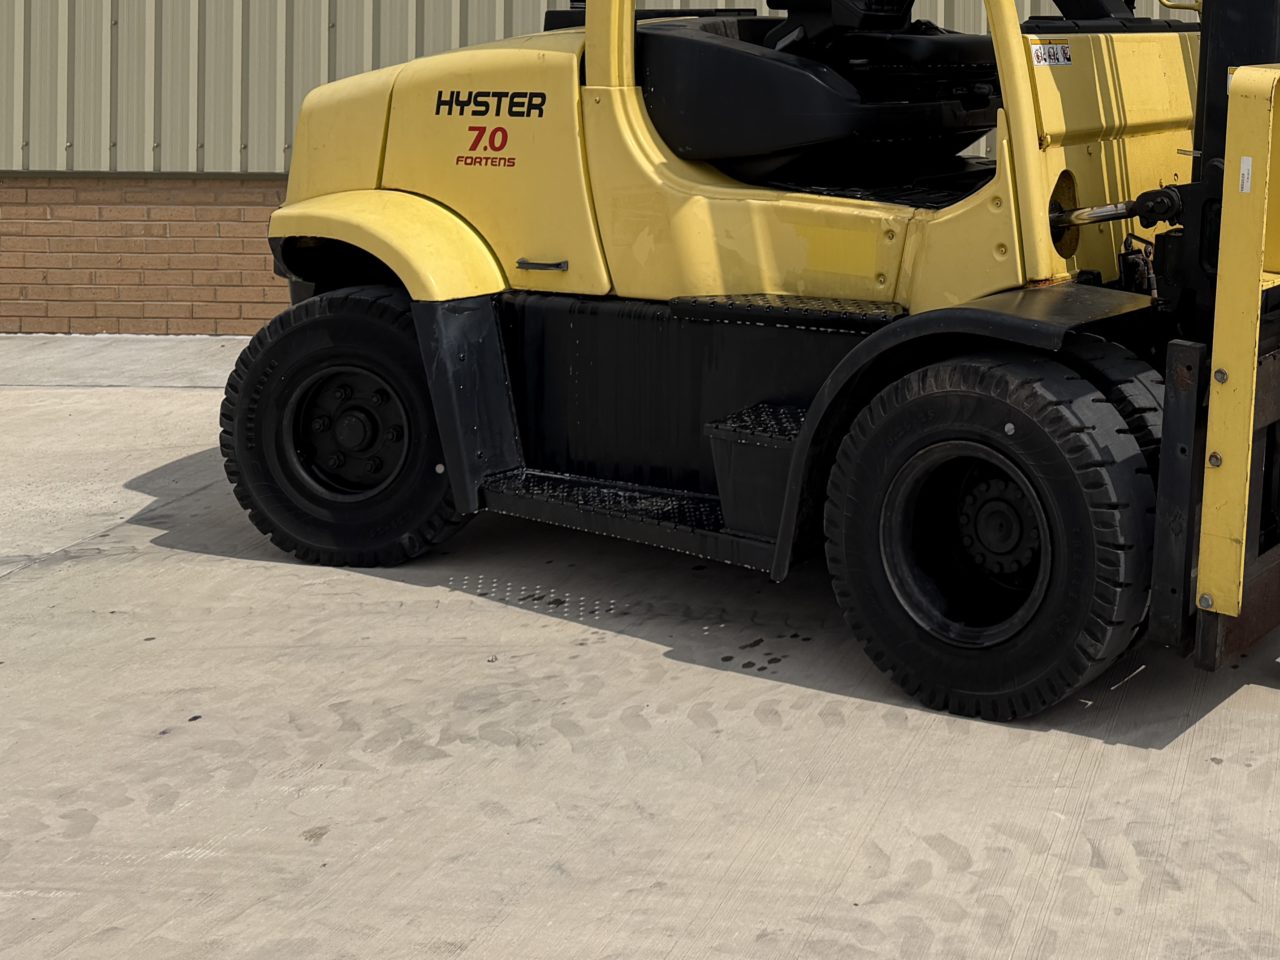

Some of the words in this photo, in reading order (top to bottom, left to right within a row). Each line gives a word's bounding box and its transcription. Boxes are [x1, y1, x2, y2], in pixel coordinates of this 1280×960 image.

[435, 90, 547, 118] HYSTER
[467, 125, 509, 152] 7.0
[455, 155, 516, 168] FORTENS
